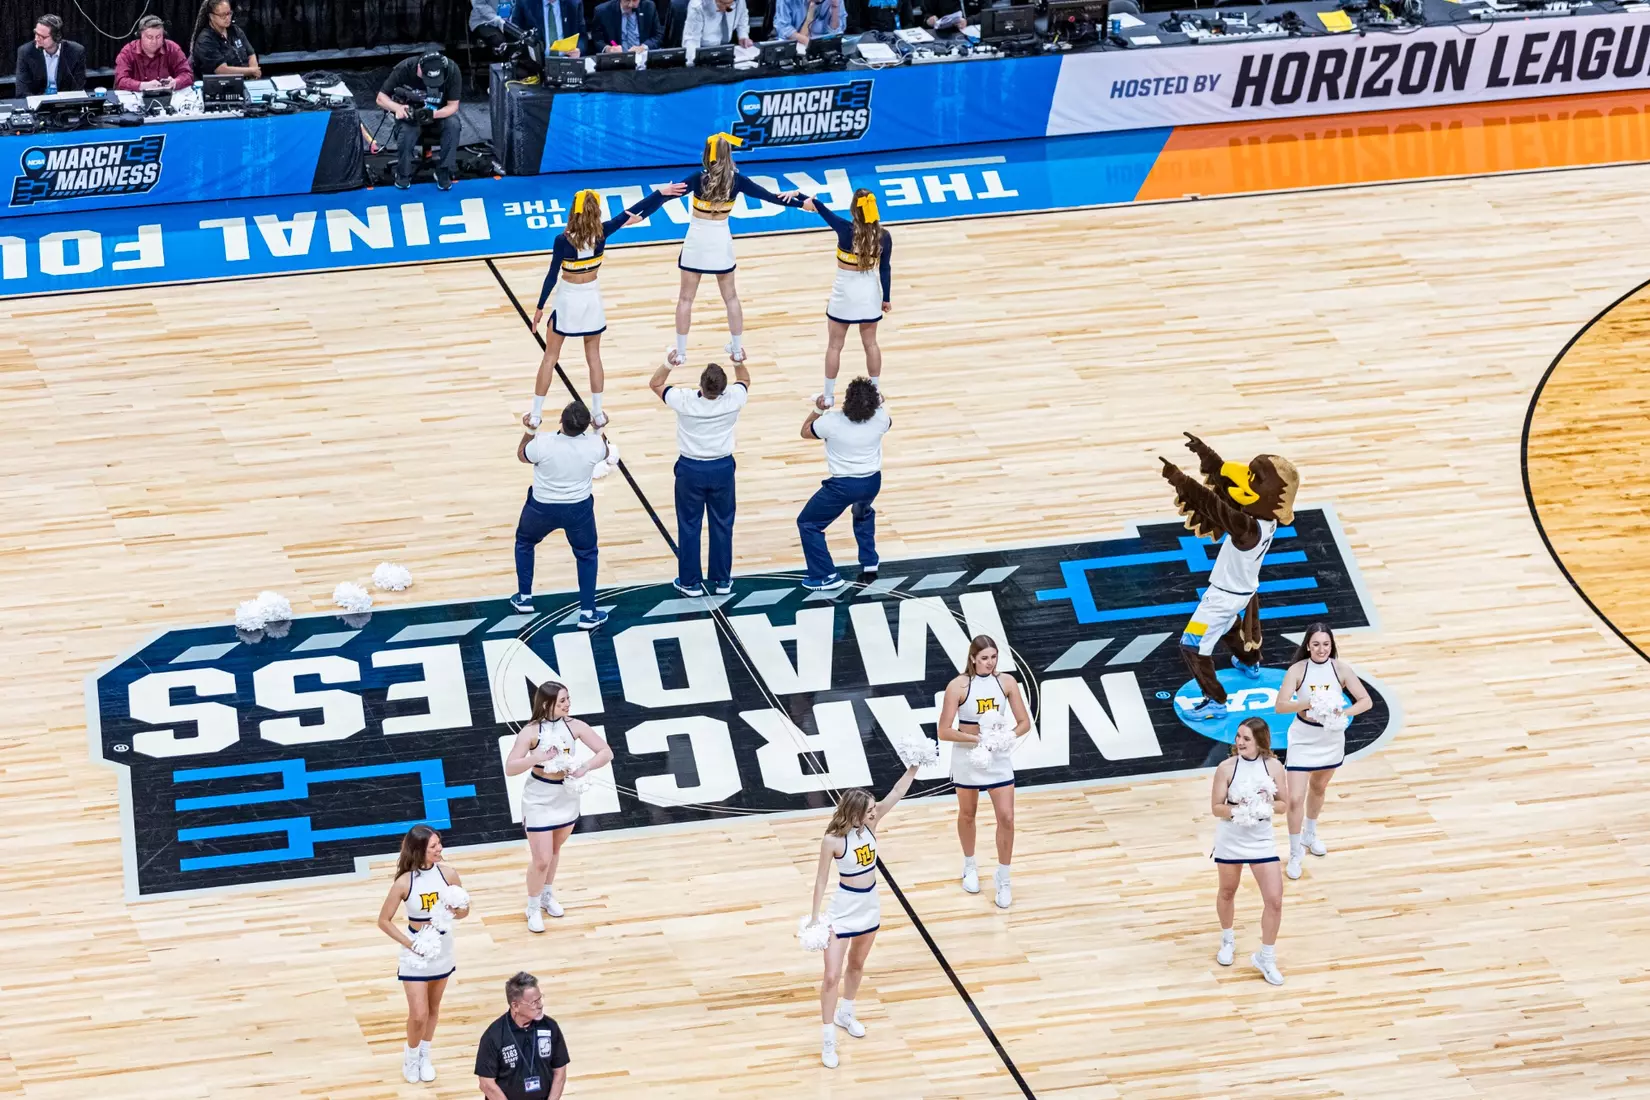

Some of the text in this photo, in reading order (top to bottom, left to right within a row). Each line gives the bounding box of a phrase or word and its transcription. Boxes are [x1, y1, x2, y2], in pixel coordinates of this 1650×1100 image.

[1231, 25, 1650, 108] HORIZON LEAGU
[1110, 74, 1222, 99] HOSTED BY
[743, 103, 760, 111] NCAA
[762, 89, 834, 116] MARCH
[771, 108, 867, 138] MADNESS
[27, 158, 45, 166] NCAA
[46, 145, 123, 170] MARCH
[54, 163, 158, 191] MADNESS
[879, 170, 1019, 207] THE
[503, 198, 566, 216] THE
[200, 198, 490, 261] FINAL
[526, 214, 568, 229] TO
[128, 591, 1018, 758] MADNESS
[498, 670, 1162, 824] MARCH
[853, 843, 875, 866] MU
